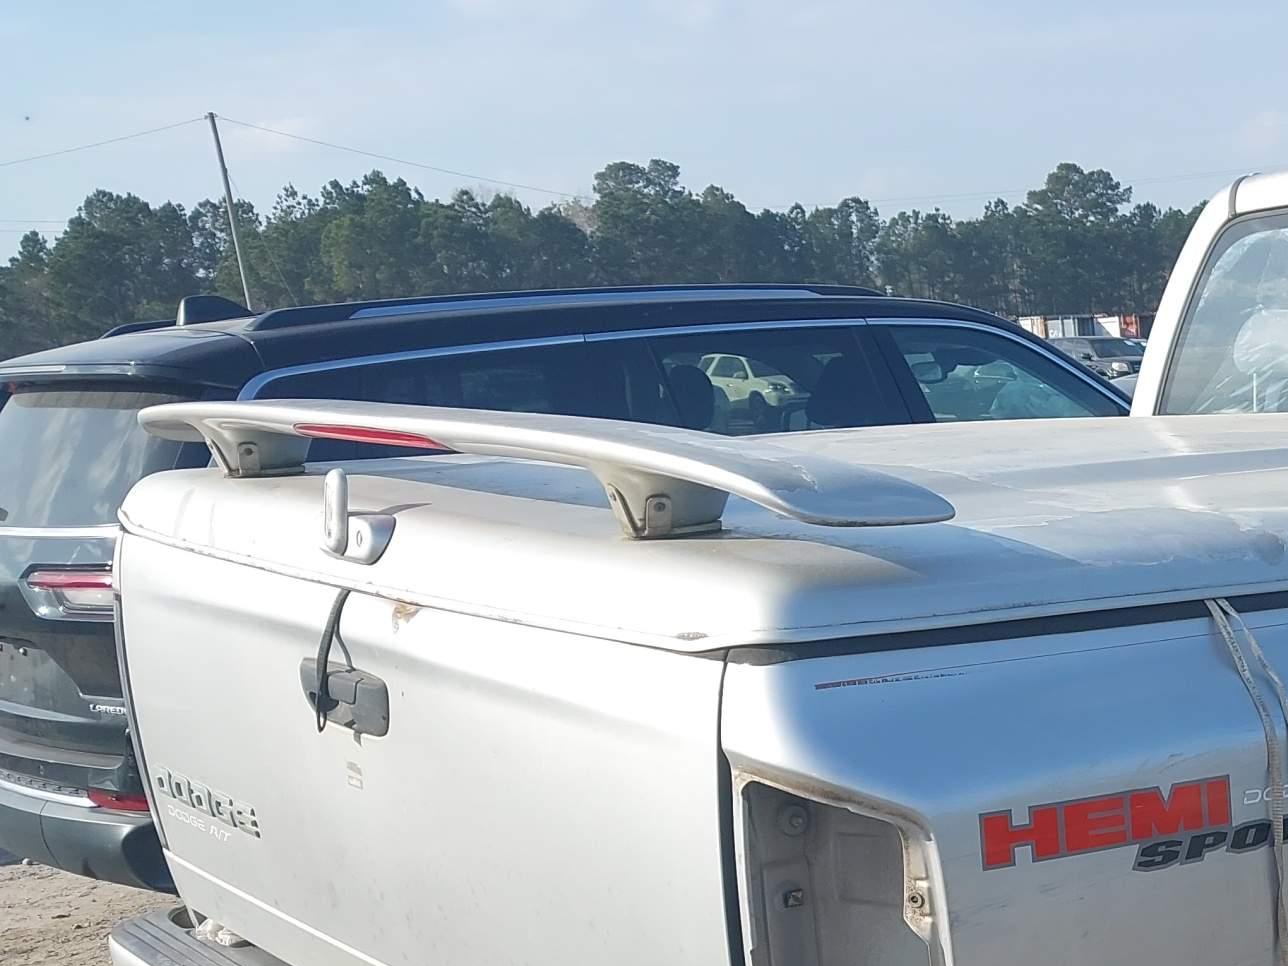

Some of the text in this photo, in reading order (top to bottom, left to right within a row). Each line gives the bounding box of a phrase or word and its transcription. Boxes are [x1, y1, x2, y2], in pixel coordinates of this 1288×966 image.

[154, 766, 262, 840] DODGE
[167, 804, 207, 832] DODGE
[978, 774, 1233, 872] HEMI
